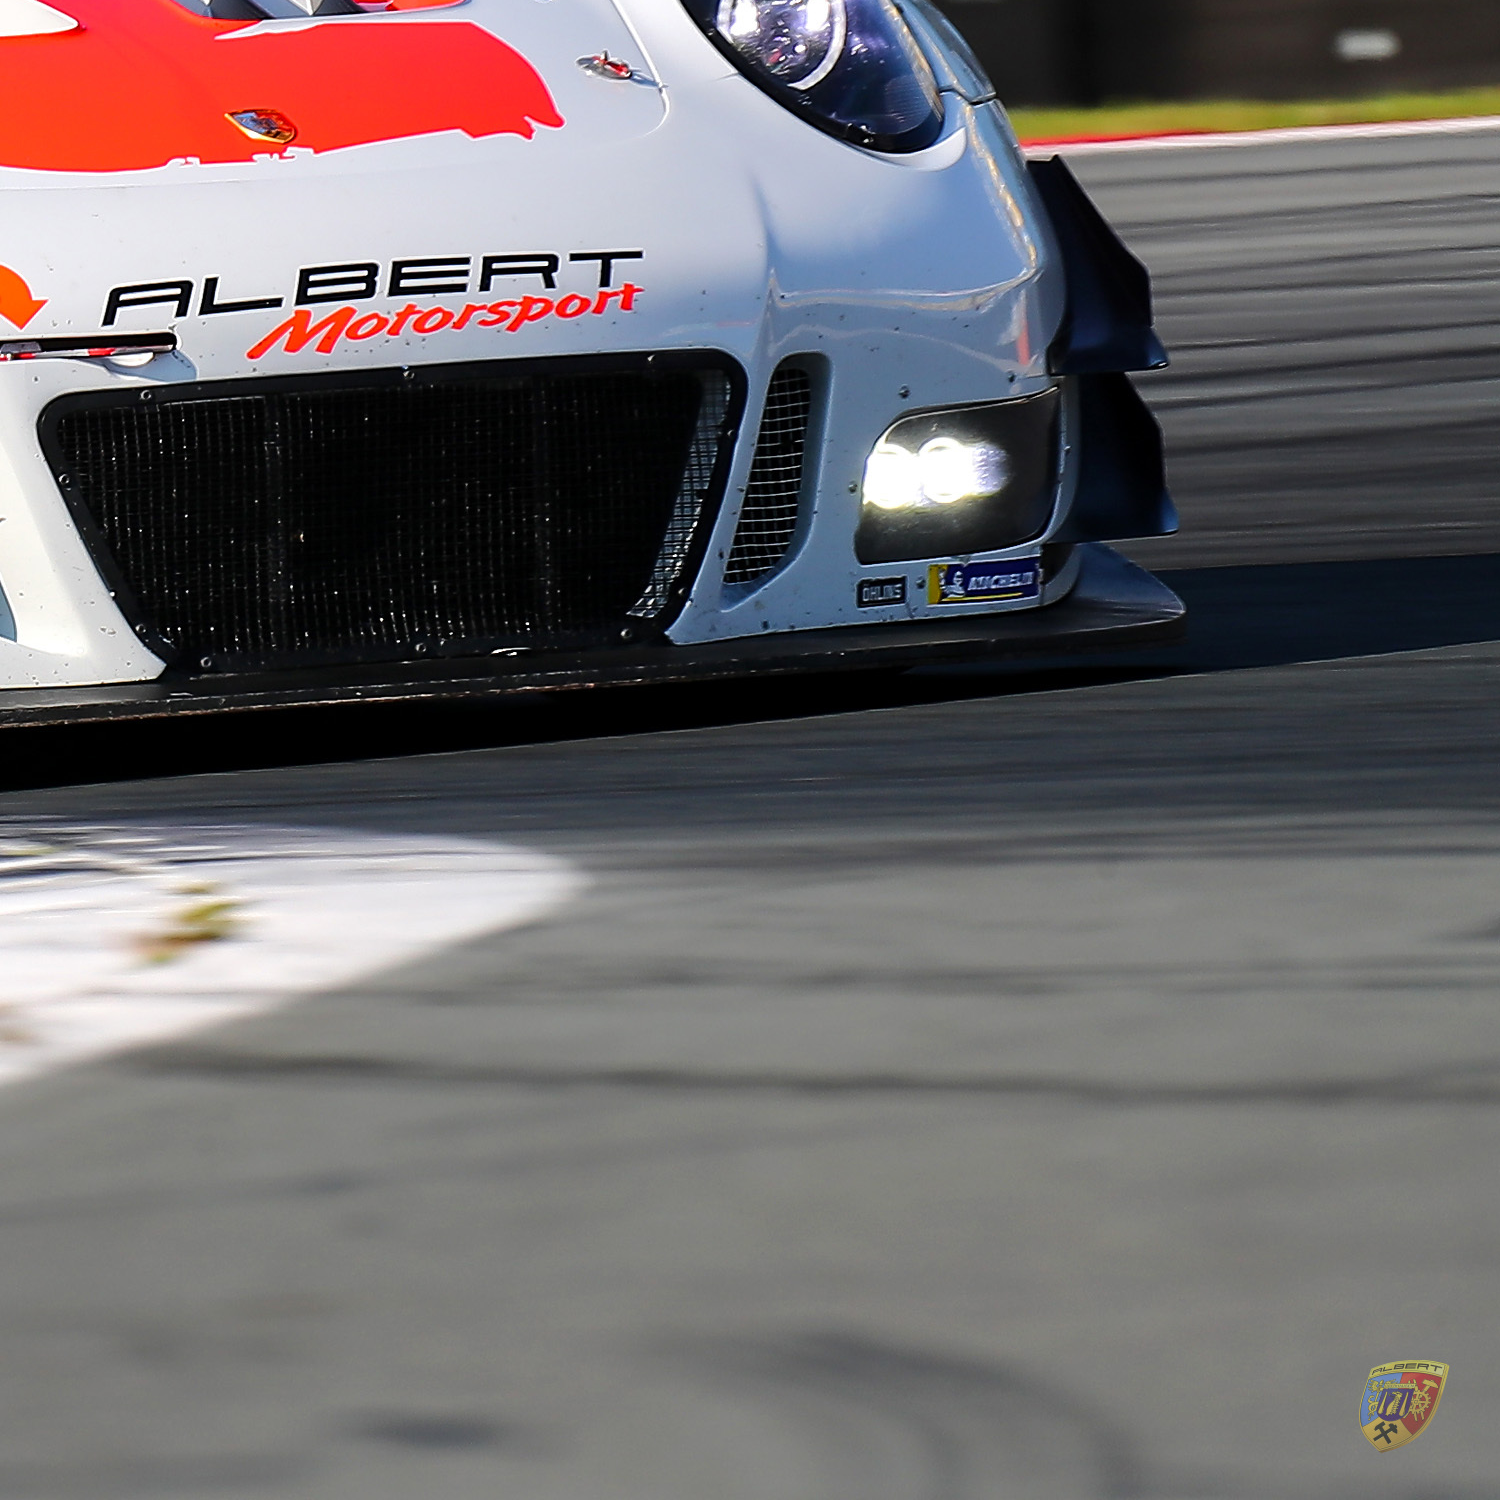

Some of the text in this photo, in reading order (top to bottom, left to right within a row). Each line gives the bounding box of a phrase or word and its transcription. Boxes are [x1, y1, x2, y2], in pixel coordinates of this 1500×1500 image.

[102, 250, 644, 326] ALBERT
[246, 282, 644, 360] Motorsport
[967, 571, 1035, 591] MICHELIN
